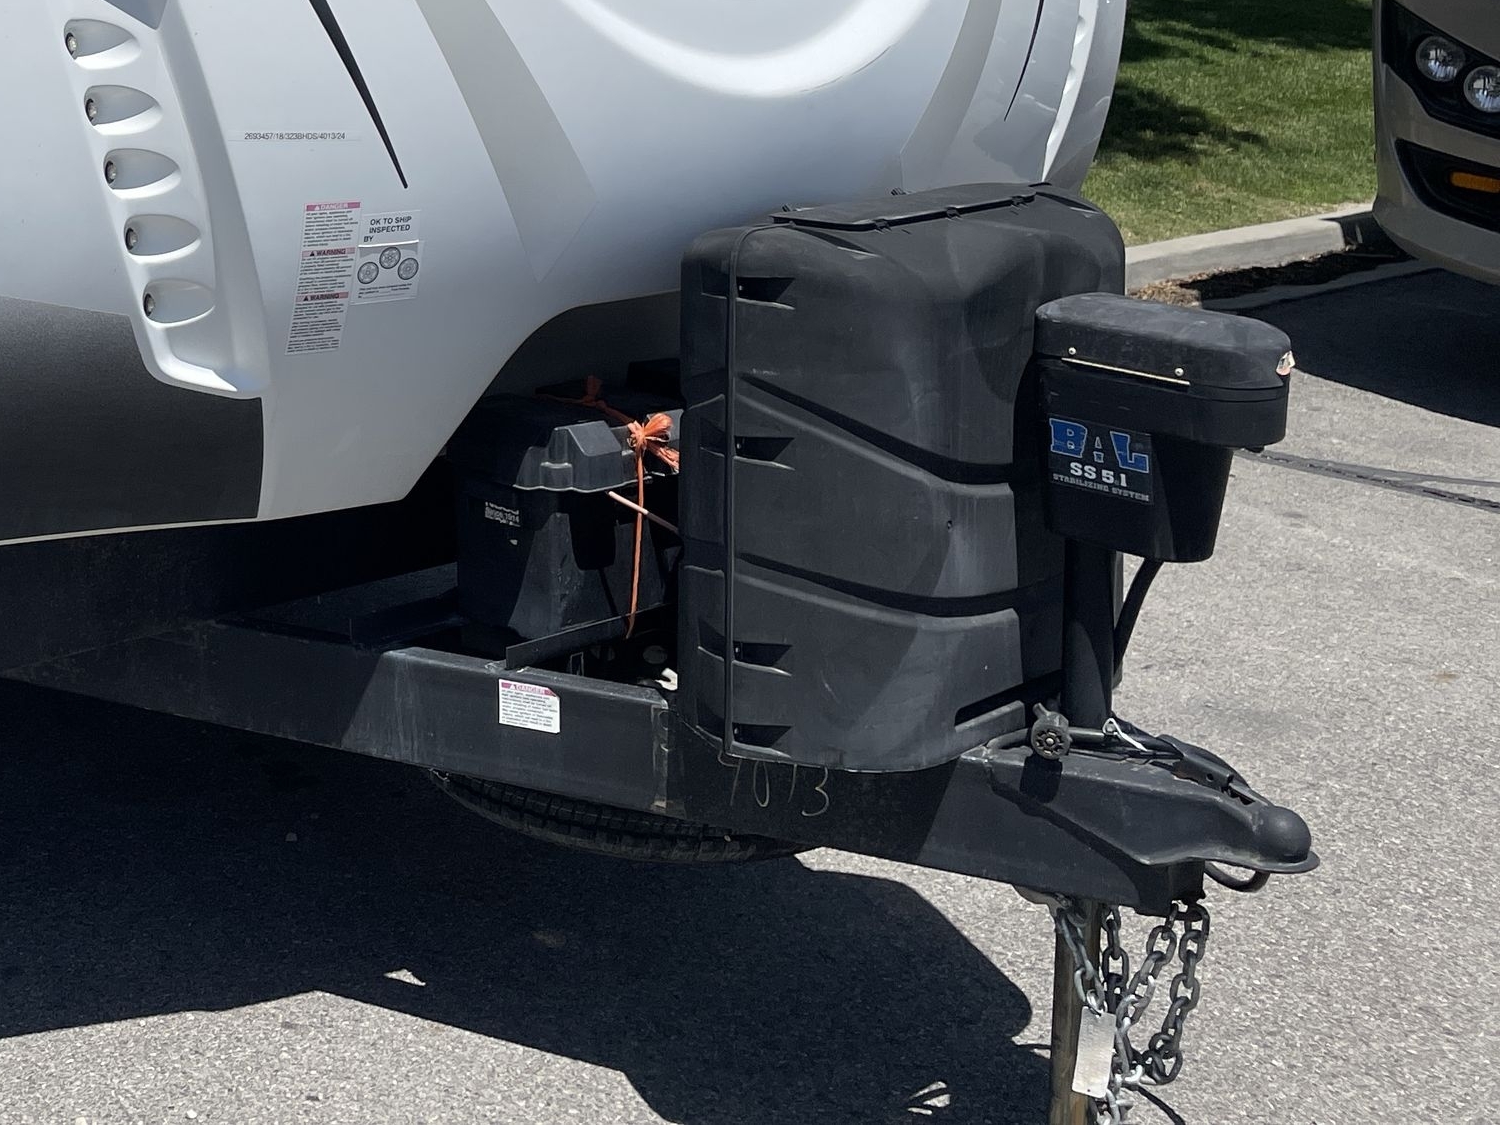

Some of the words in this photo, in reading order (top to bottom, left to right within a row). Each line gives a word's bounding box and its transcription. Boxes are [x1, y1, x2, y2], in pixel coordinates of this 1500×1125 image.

[370, 218, 381, 226] OK
[383, 217, 393, 225] TO
[369, 224, 411, 234] INSPECTED
[363, 235, 374, 243] BY
[316, 248, 346, 256] WARNING
[310, 293, 340, 301] WARNING
[1069, 461, 1097, 480] SS
[1052, 473, 1110, 492] STABILIZING
[1111, 486, 1150, 502] SYSTEM
